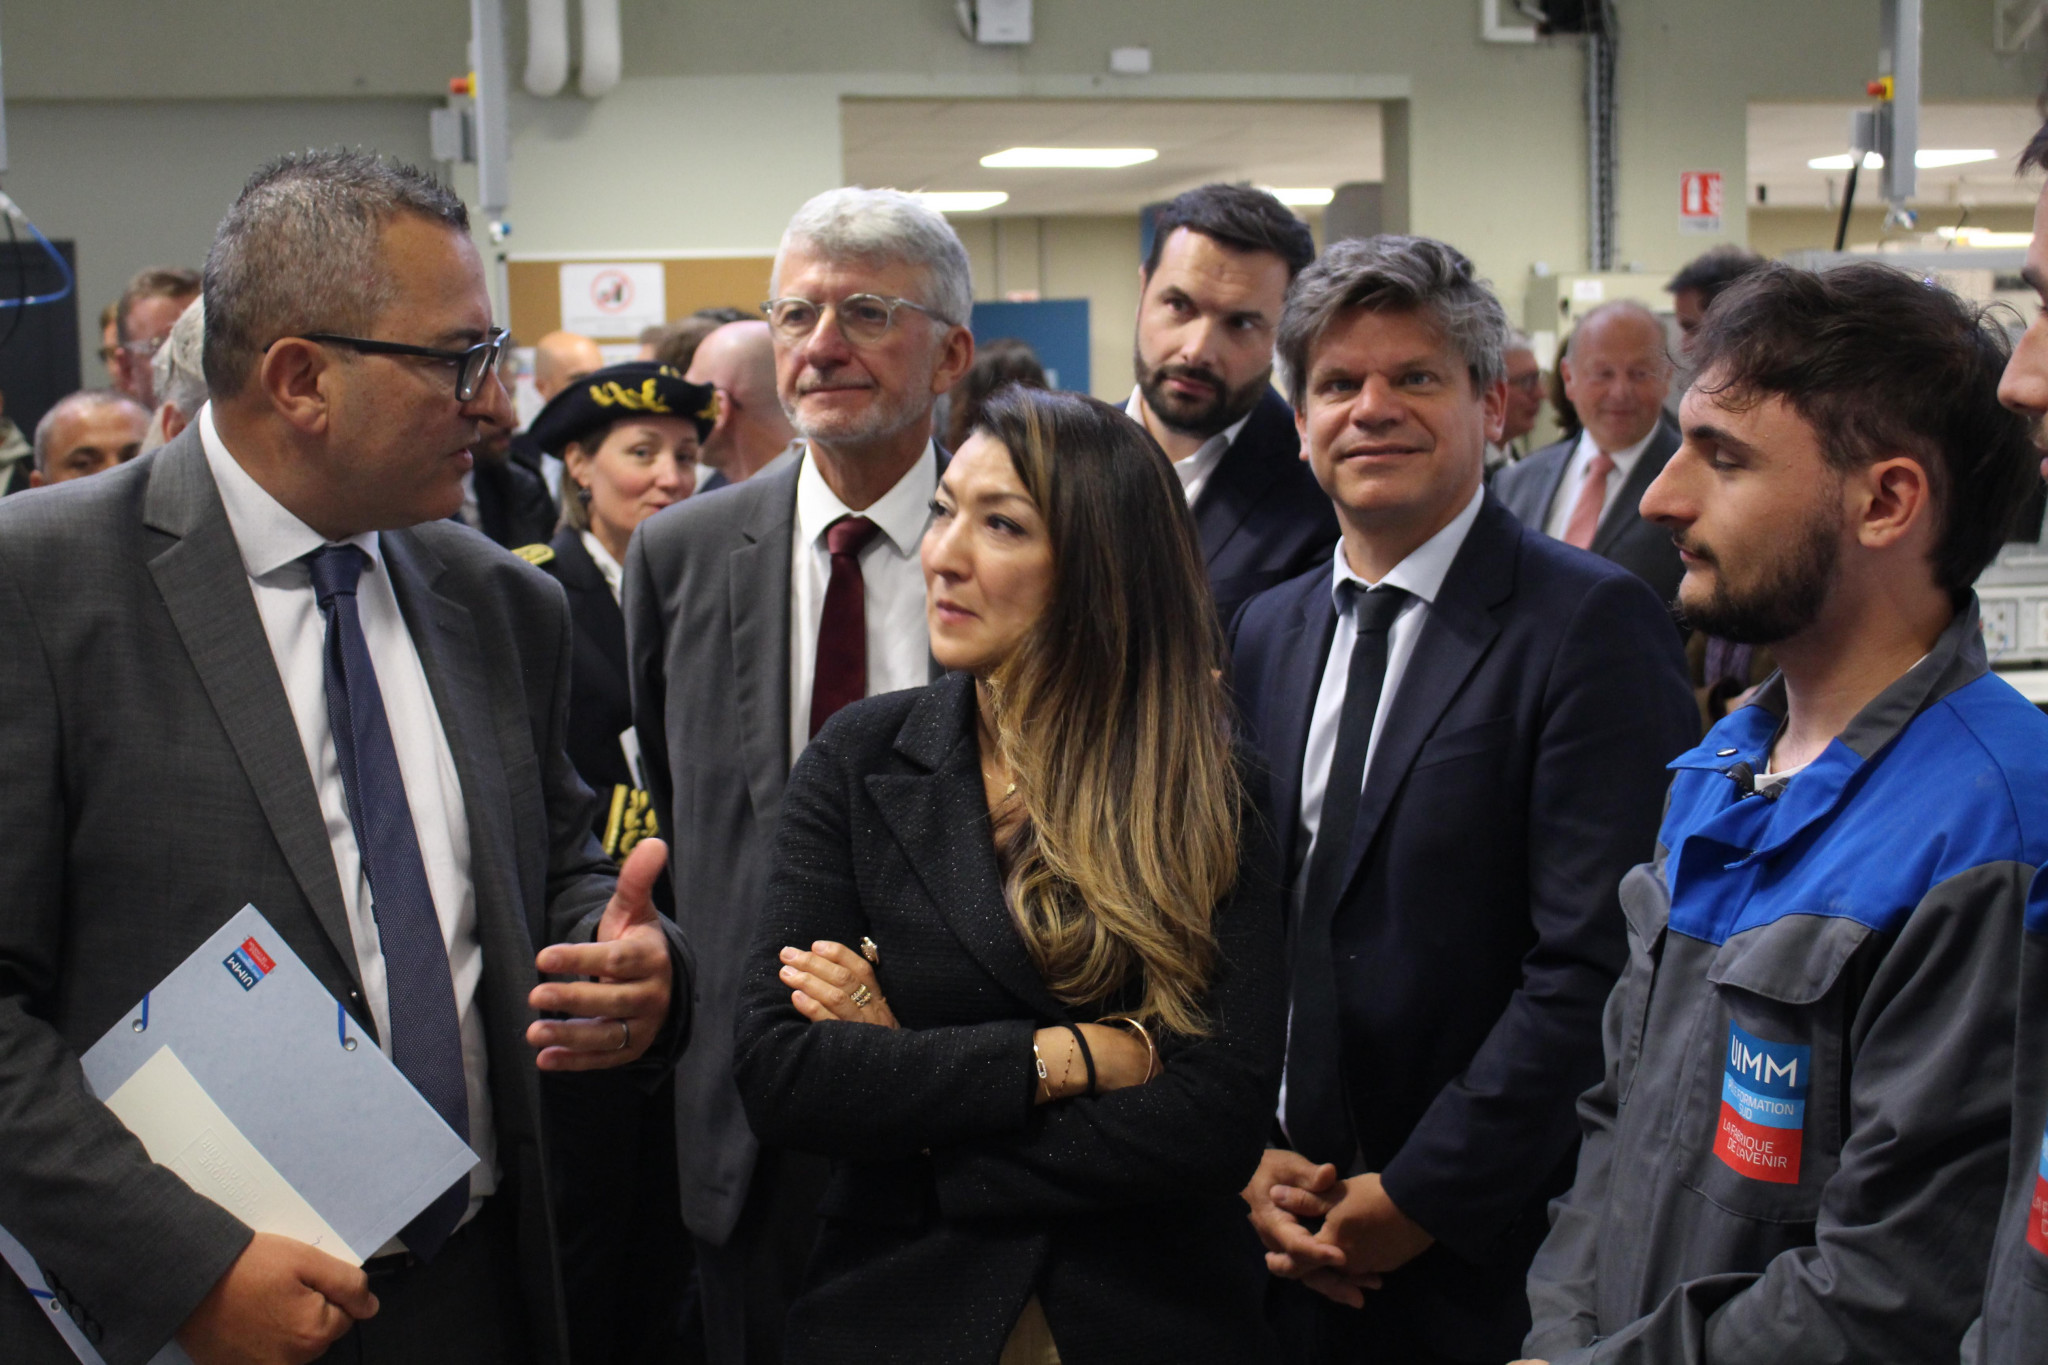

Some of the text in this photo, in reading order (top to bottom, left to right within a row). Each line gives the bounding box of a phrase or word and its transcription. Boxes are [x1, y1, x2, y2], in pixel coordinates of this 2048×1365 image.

[227, 956, 254, 987] UIMM
[1731, 1034, 1797, 1087] UIMM
[1739, 1102, 1753, 1119] SUD
[1723, 1118, 1773, 1153] LA FABRIQUE
[1727, 1137, 1737, 1152] DE
